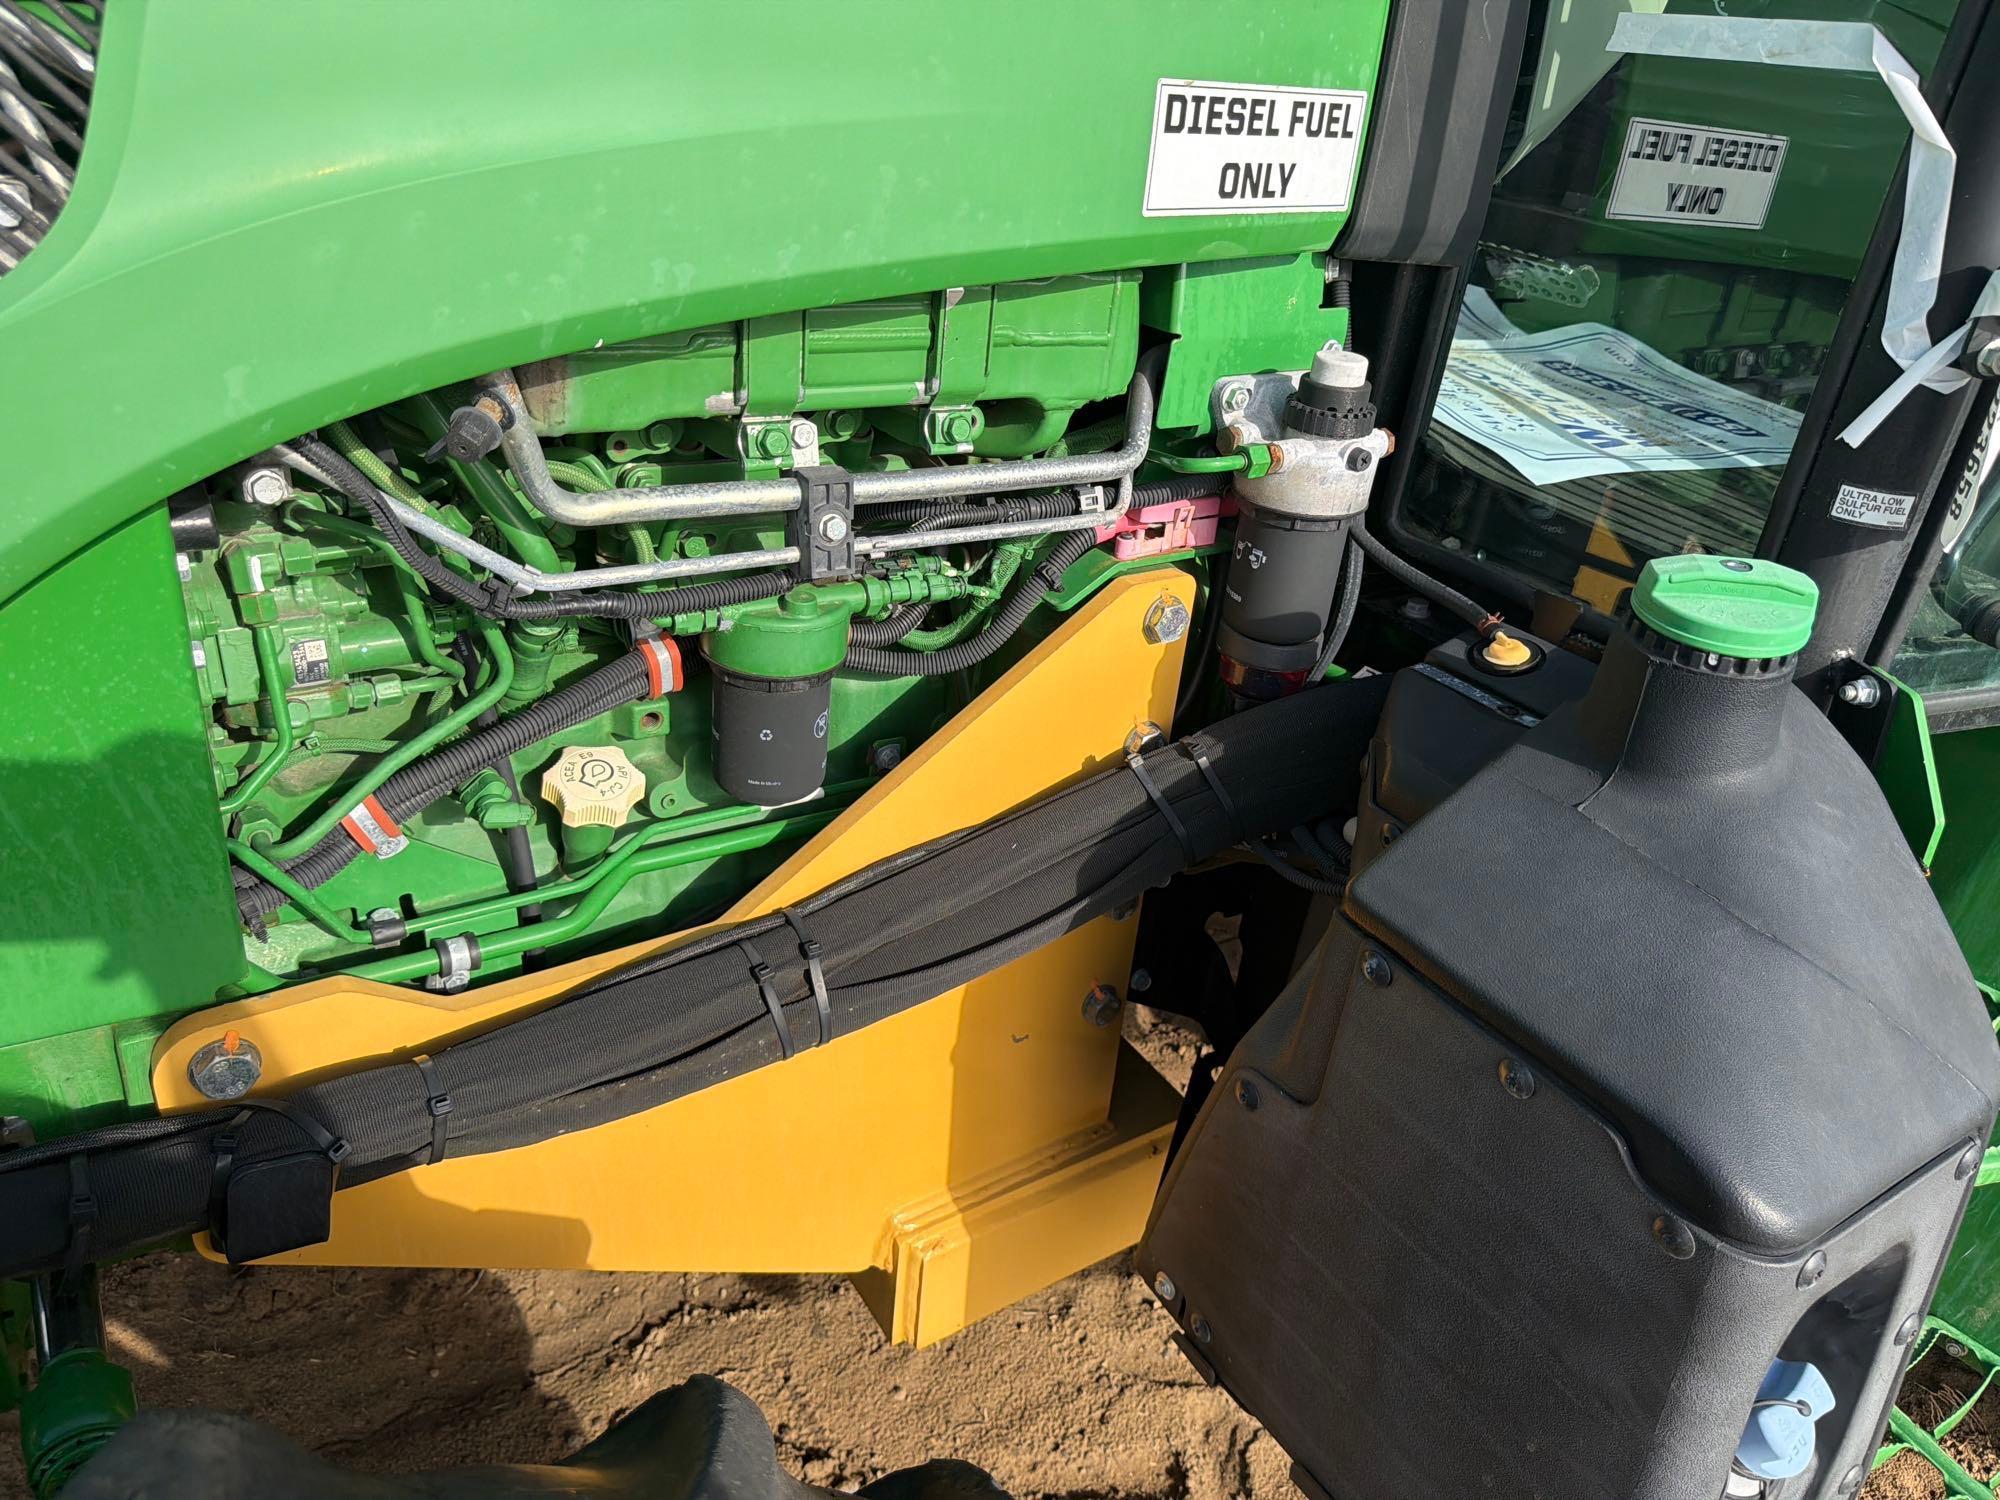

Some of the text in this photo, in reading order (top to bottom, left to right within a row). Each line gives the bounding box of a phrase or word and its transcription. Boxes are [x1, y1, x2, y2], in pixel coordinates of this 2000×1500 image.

[1164, 94, 1354, 138] DIESEL FUEL
[1218, 162, 1297, 199] ONLY
[1835, 506, 1866, 520] ONLY
[1838, 497, 1907, 516] SULFUR FUEL
[1842, 488, 1905, 507] ULTRA LOW
[564, 751, 594, 783] ACEA E9
[600, 765, 628, 797] API CJ-4
